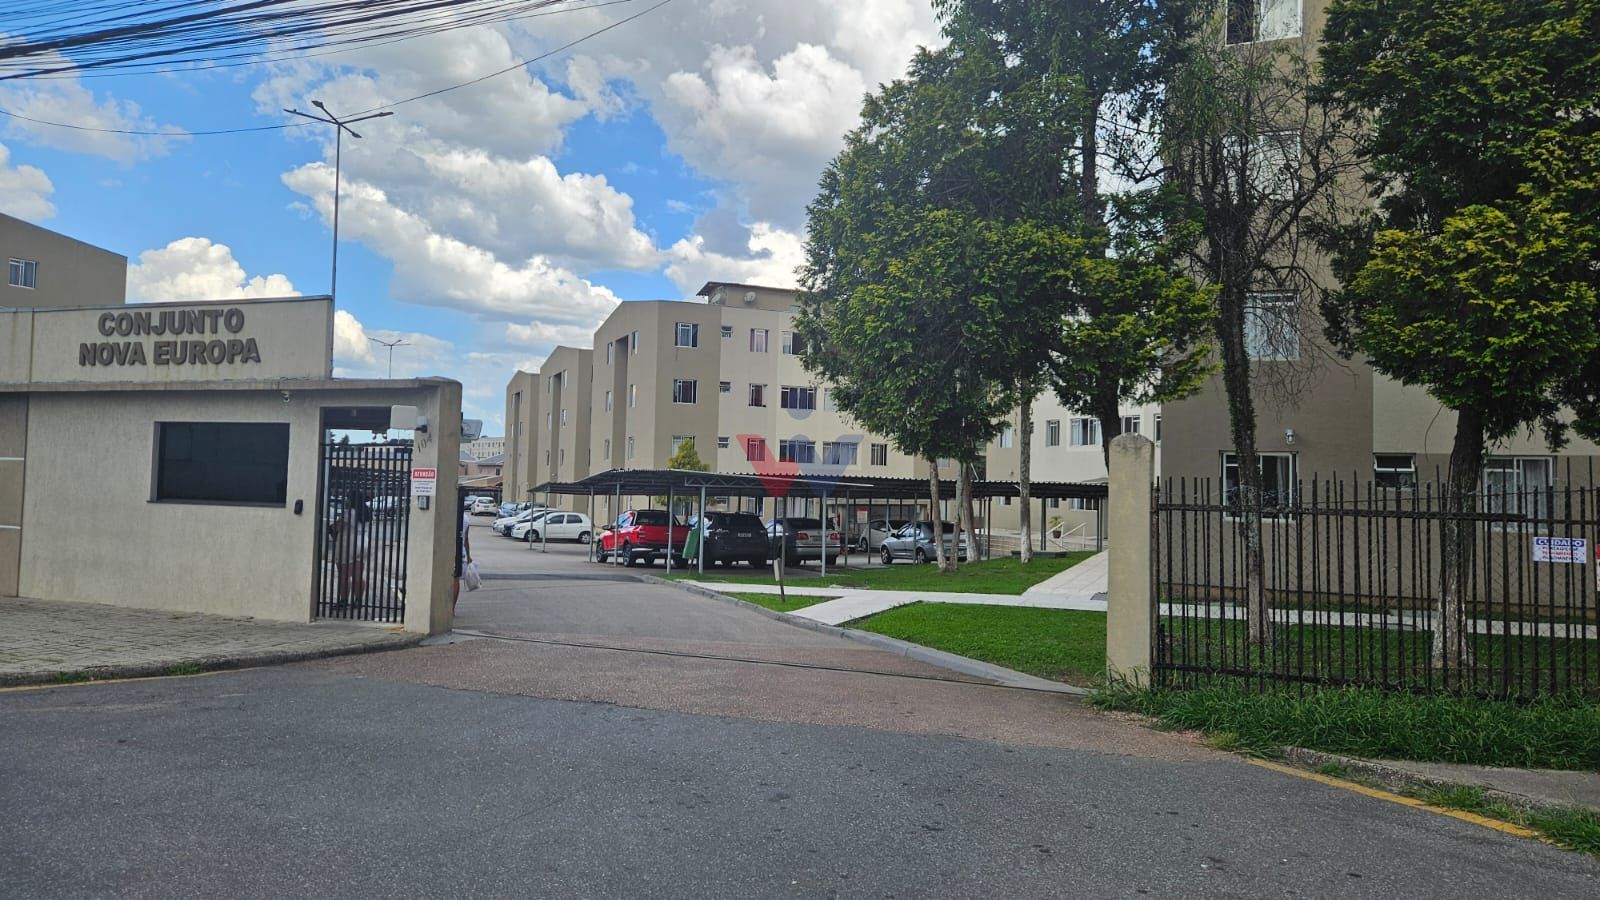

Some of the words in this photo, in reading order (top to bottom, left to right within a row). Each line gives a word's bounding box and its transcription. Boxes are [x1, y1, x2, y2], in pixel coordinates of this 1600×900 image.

[98, 308, 245, 336] CONJUNTO
[79, 341, 147, 367] NOVA
[153, 337, 261, 365] EUROPA
